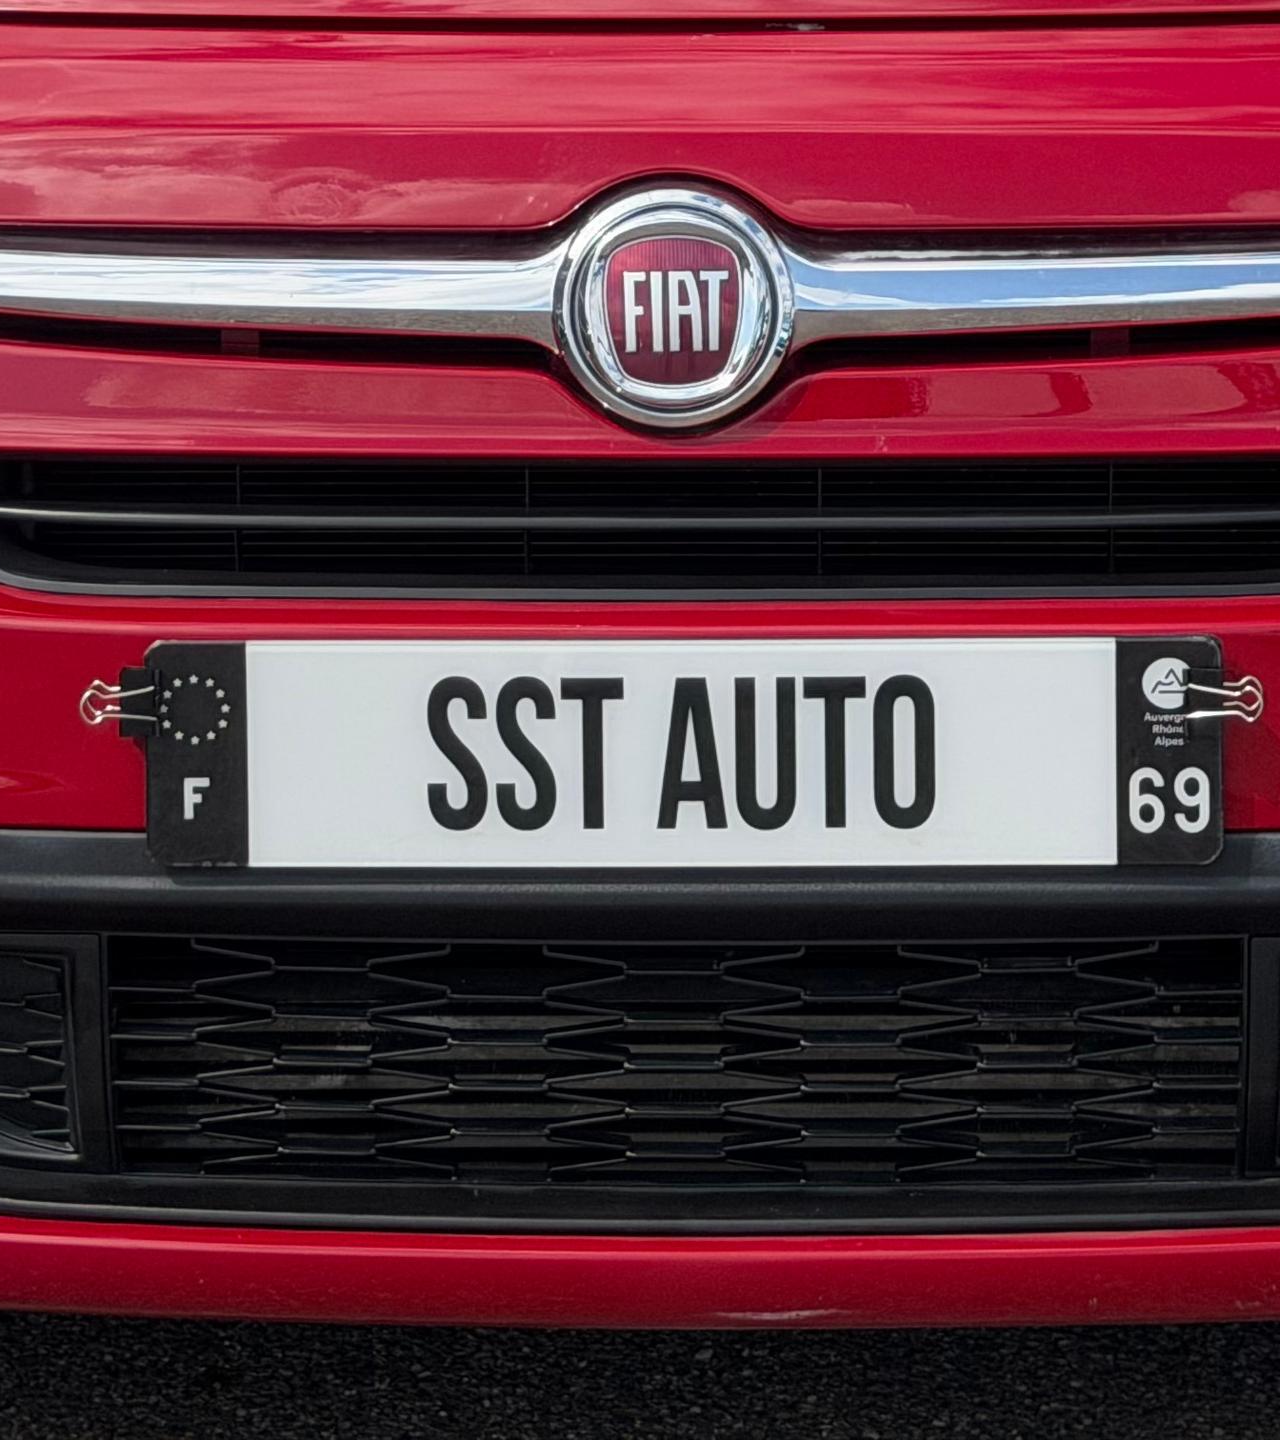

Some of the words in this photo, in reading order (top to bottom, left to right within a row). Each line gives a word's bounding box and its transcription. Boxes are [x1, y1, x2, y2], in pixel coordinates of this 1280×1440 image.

[622, 270, 729, 353] FIAT
[1143, 711, 1187, 724] Auverg
[1154, 735, 1185, 748] Alpes
[426, 675, 624, 832] SST
[657, 673, 937, 832] AUTO
[183, 777, 211, 820] F
[1128, 766, 1211, 834] 69
